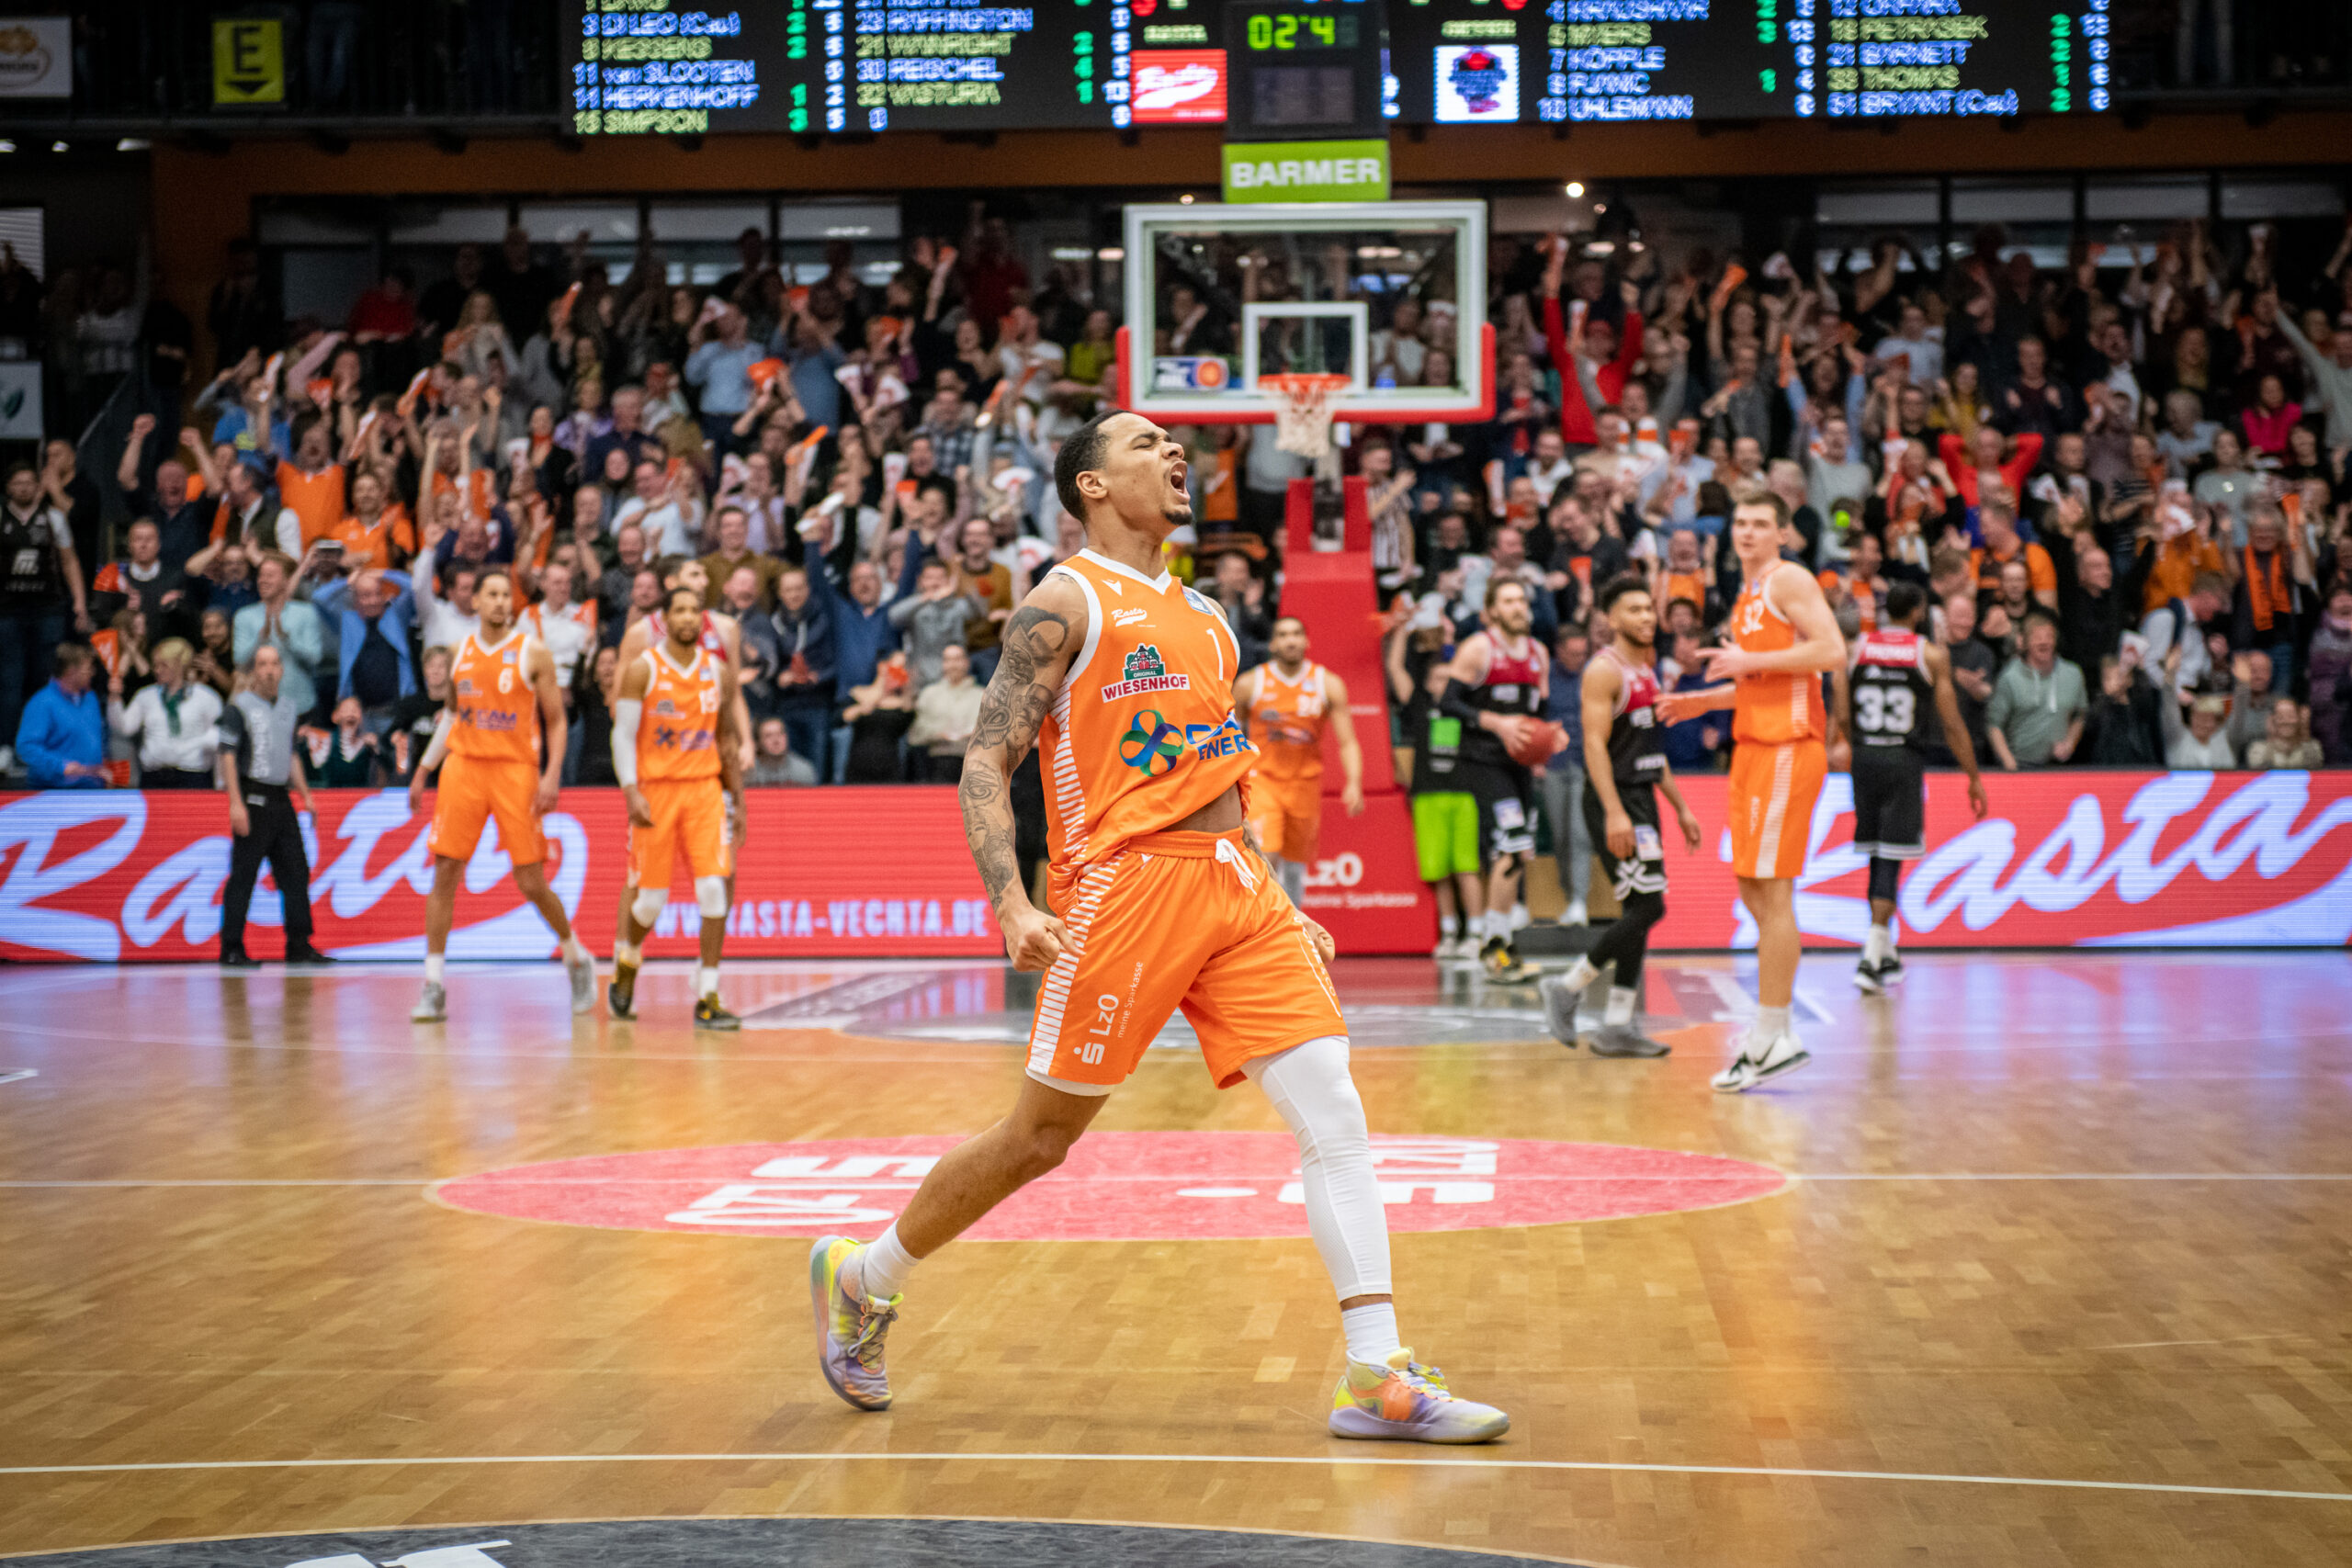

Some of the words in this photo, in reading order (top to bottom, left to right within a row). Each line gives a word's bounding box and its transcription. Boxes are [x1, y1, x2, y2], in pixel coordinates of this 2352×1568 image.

[233, 26, 266, 74] E
[1229, 157, 1382, 189] BARMER
[1112, 607, 1147, 623] Rasta
[498, 667, 514, 694] 6
[1102, 675, 1188, 701] WIESENHOF
[1855, 684, 1917, 734] 33
[1090, 994, 1119, 1037] LzO
[1117, 1010, 1131, 1039] meine
[1124, 962, 1144, 1010] Sparkasse
